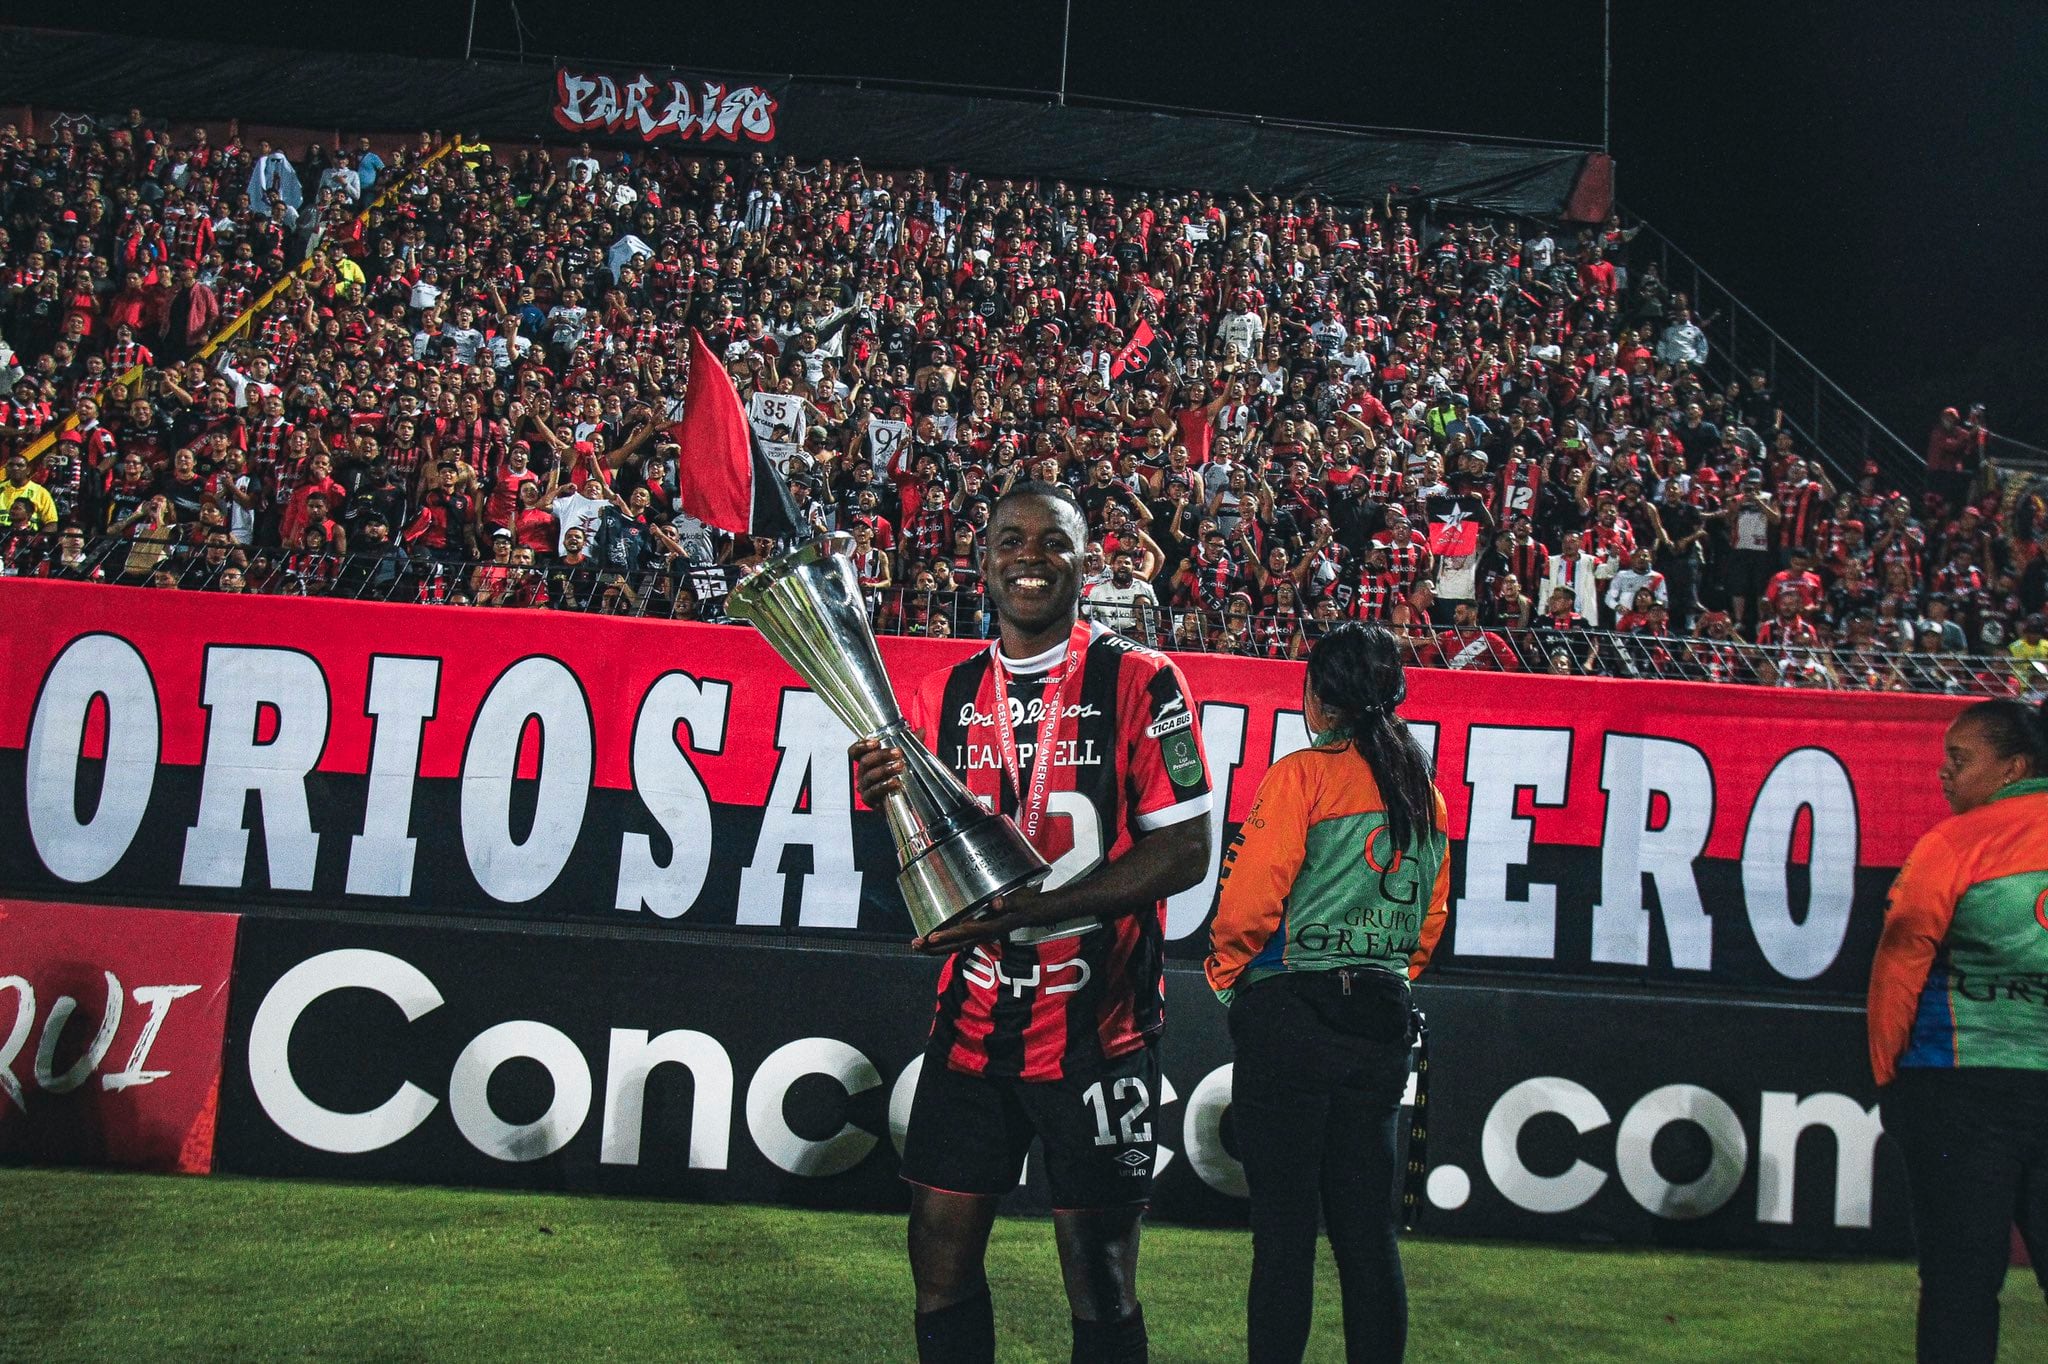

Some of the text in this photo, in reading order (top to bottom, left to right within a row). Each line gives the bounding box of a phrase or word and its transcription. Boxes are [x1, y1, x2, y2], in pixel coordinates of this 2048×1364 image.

[556, 68, 776, 140] PARAISO
[763, 399, 787, 420] 35
[1505, 485, 1533, 510] 12
[1068, 650, 1079, 673] CUP
[957, 697, 1102, 727] Dos Pios
[997, 703, 1012, 754] CENTRAL
[1042, 692, 1060, 744] CENTRAL
[1152, 713, 1191, 735] TICA BUS
[955, 738, 1102, 771] J.CAPELL
[26, 631, 863, 931] ORIOSA
[1031, 746, 1051, 810] AMERICAN
[1027, 811, 1040, 837] CUP
[1344, 906, 1418, 933] GRUPO
[962, 946, 1091, 998] BYD
[248, 948, 1884, 1230] Conc.com
[1082, 1076, 1152, 1146] 12
